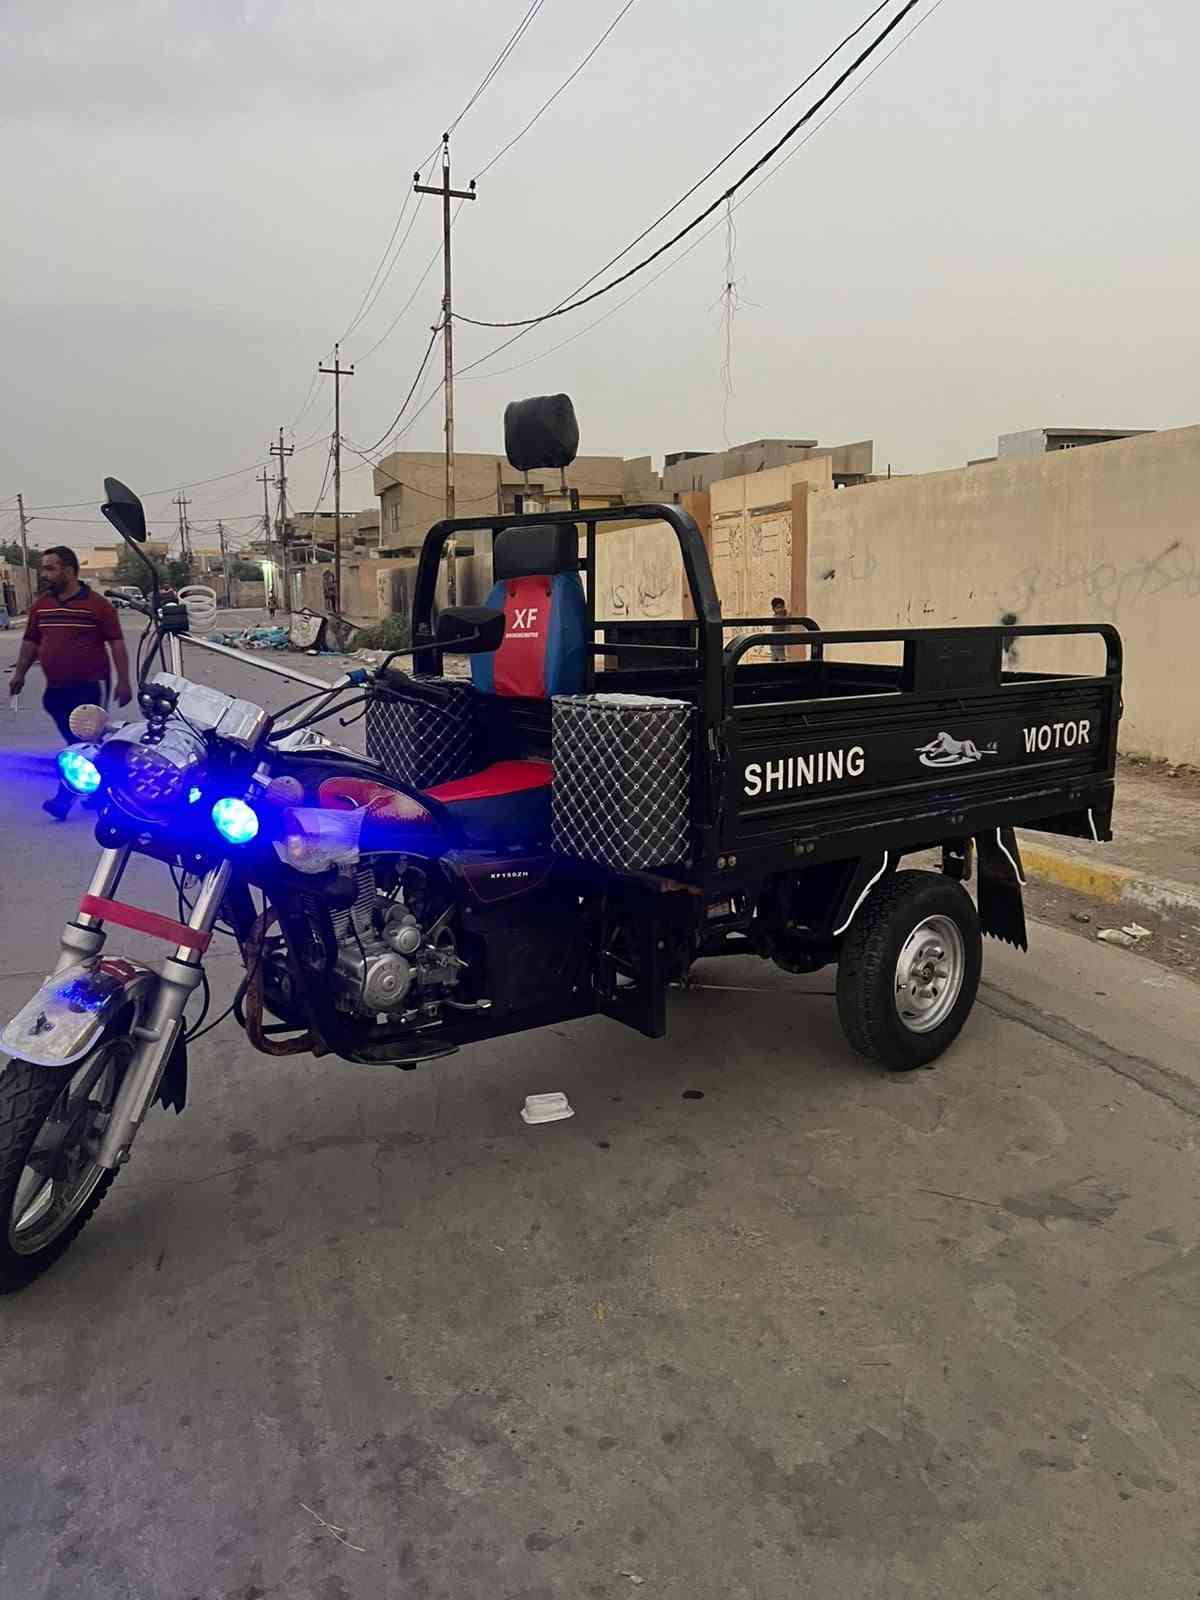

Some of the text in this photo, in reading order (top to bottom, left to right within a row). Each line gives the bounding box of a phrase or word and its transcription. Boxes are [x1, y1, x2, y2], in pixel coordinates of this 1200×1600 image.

[512, 607, 538, 629] XF
[743, 719, 1090, 796] SHINING MOTOR
